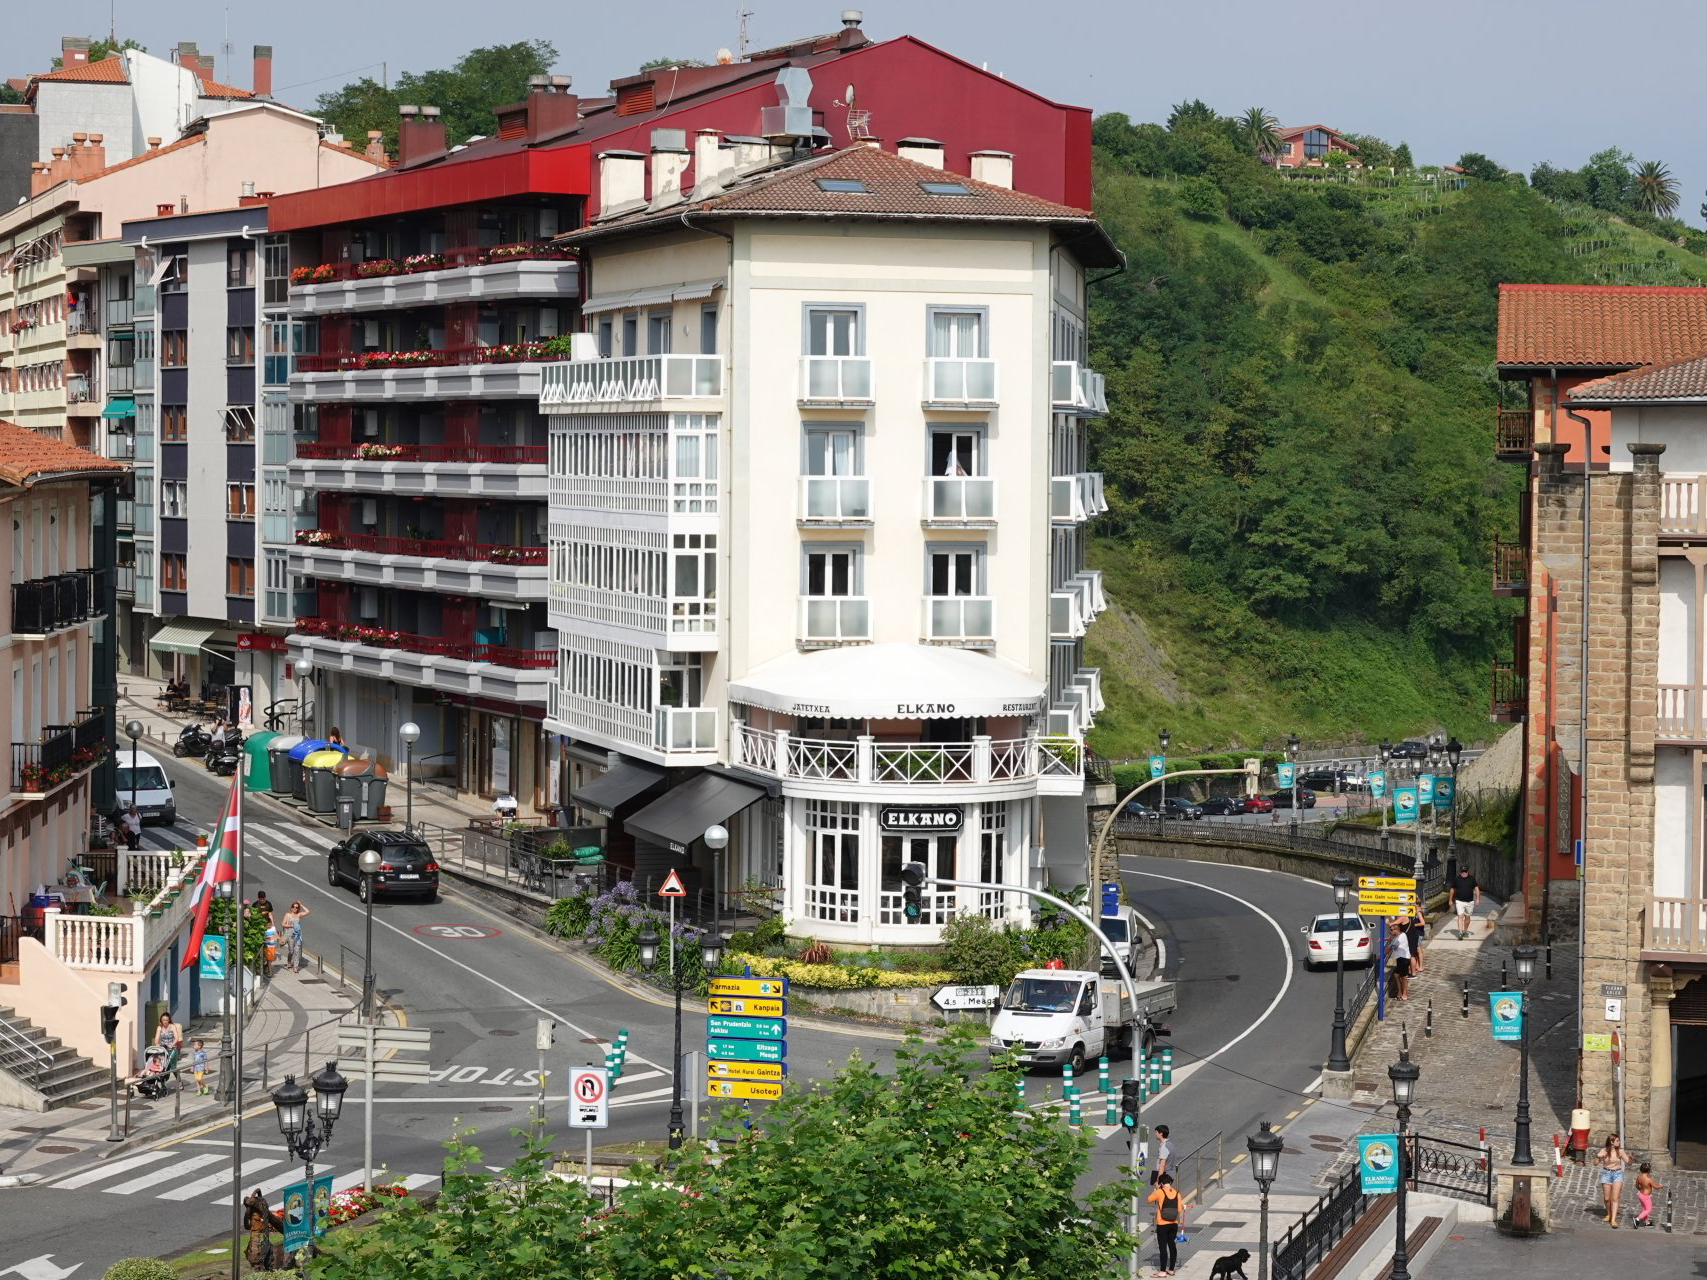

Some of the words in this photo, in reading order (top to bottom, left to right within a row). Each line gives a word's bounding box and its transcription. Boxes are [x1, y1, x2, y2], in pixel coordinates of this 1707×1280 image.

[792, 703, 831, 713] JATETXEA
[897, 703, 956, 714] ELKANO
[887, 812, 957, 825] ELKANO
[430, 926, 486, 937] 30
[711, 983, 740, 991] Farmazia
[968, 997, 996, 1006] Meaga
[756, 1068, 781, 1076] Gaintza
[750, 1088, 779, 1096] Usotegi
